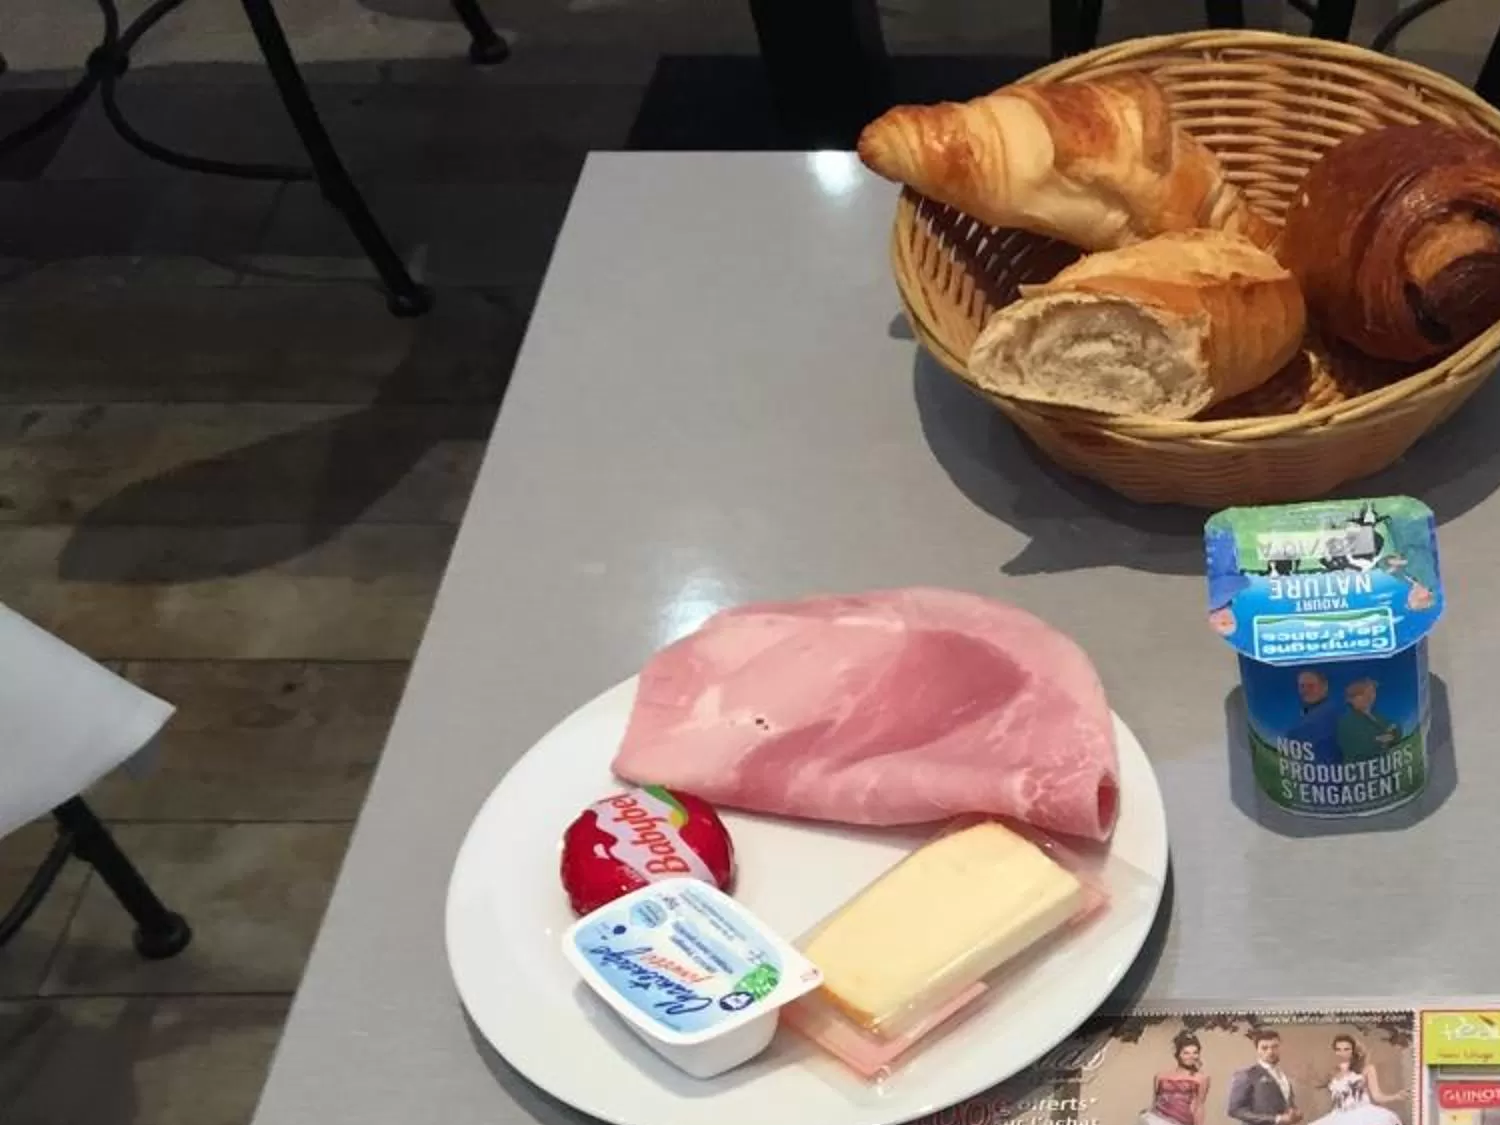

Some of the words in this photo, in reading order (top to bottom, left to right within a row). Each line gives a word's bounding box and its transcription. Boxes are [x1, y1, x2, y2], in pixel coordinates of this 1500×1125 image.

[1268, 574, 1372, 599] NATURE
[1295, 598, 1348, 611] YAOURT
[1262, 629, 1344, 644] France
[1263, 636, 1389, 656] Campagne
[1276, 736, 1315, 761] NOS
[1278, 743, 1414, 783] PRODUCTEURS
[1281, 773, 1402, 806] S'ENGAGENT
[607, 792, 691, 874] Babybel
